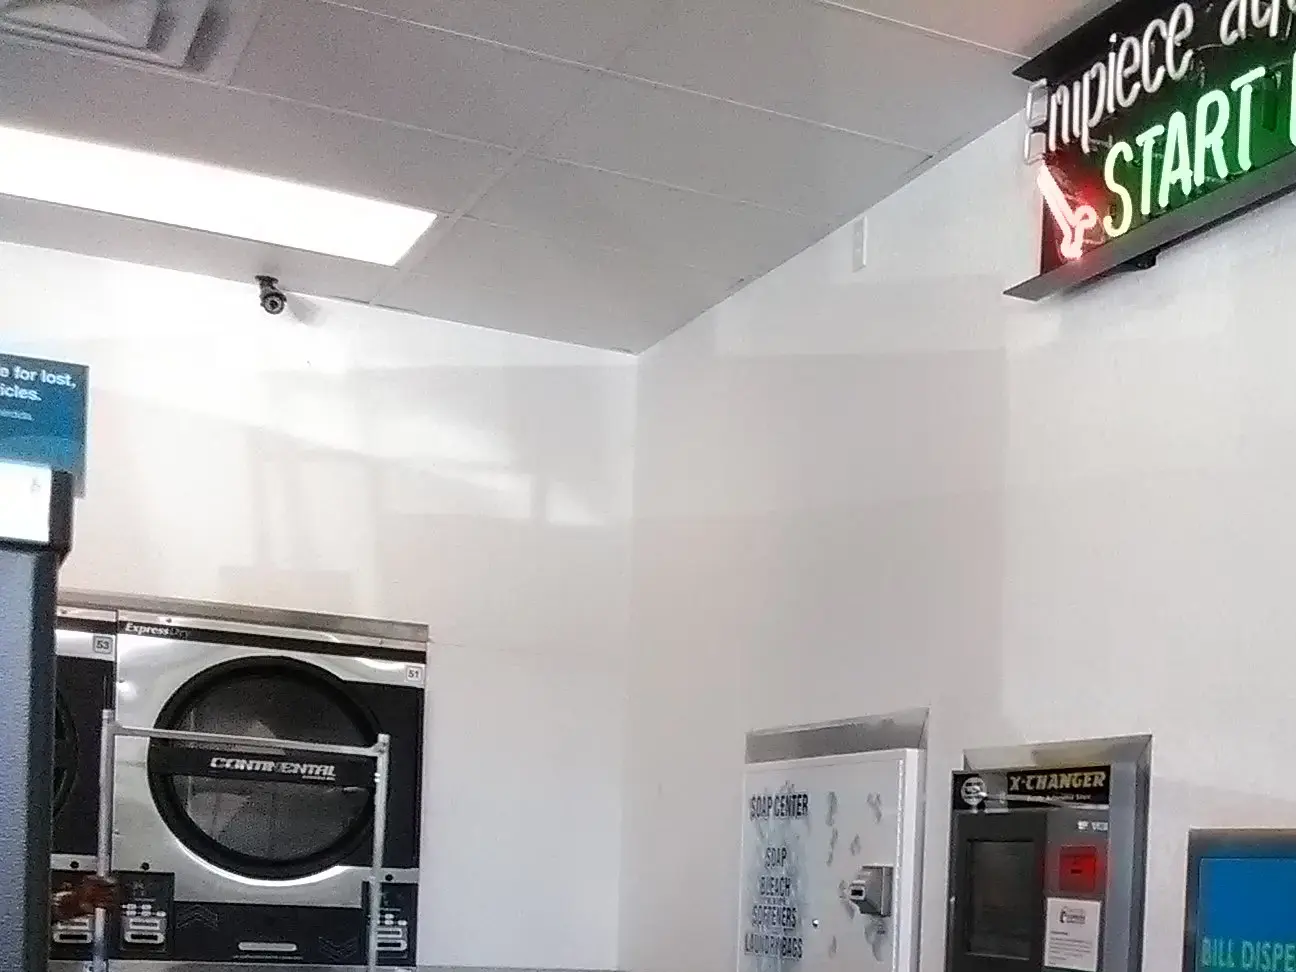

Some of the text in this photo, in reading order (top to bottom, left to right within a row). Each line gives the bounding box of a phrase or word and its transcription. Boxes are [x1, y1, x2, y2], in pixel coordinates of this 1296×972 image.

[1103, 66, 1266, 238] START
[14, 365, 37, 382] for
[41, 369, 77, 389] lost,
[96, 640, 110, 650] 53
[408, 669, 419, 679] 51
[1009, 771, 1106, 792] X-CHANGER
[750, 792, 809, 819] SOAP CENTER
[765, 846, 787, 868] SOAP
[760, 875, 791, 898] BLEACH
[1202, 936, 1236, 969] BILL
